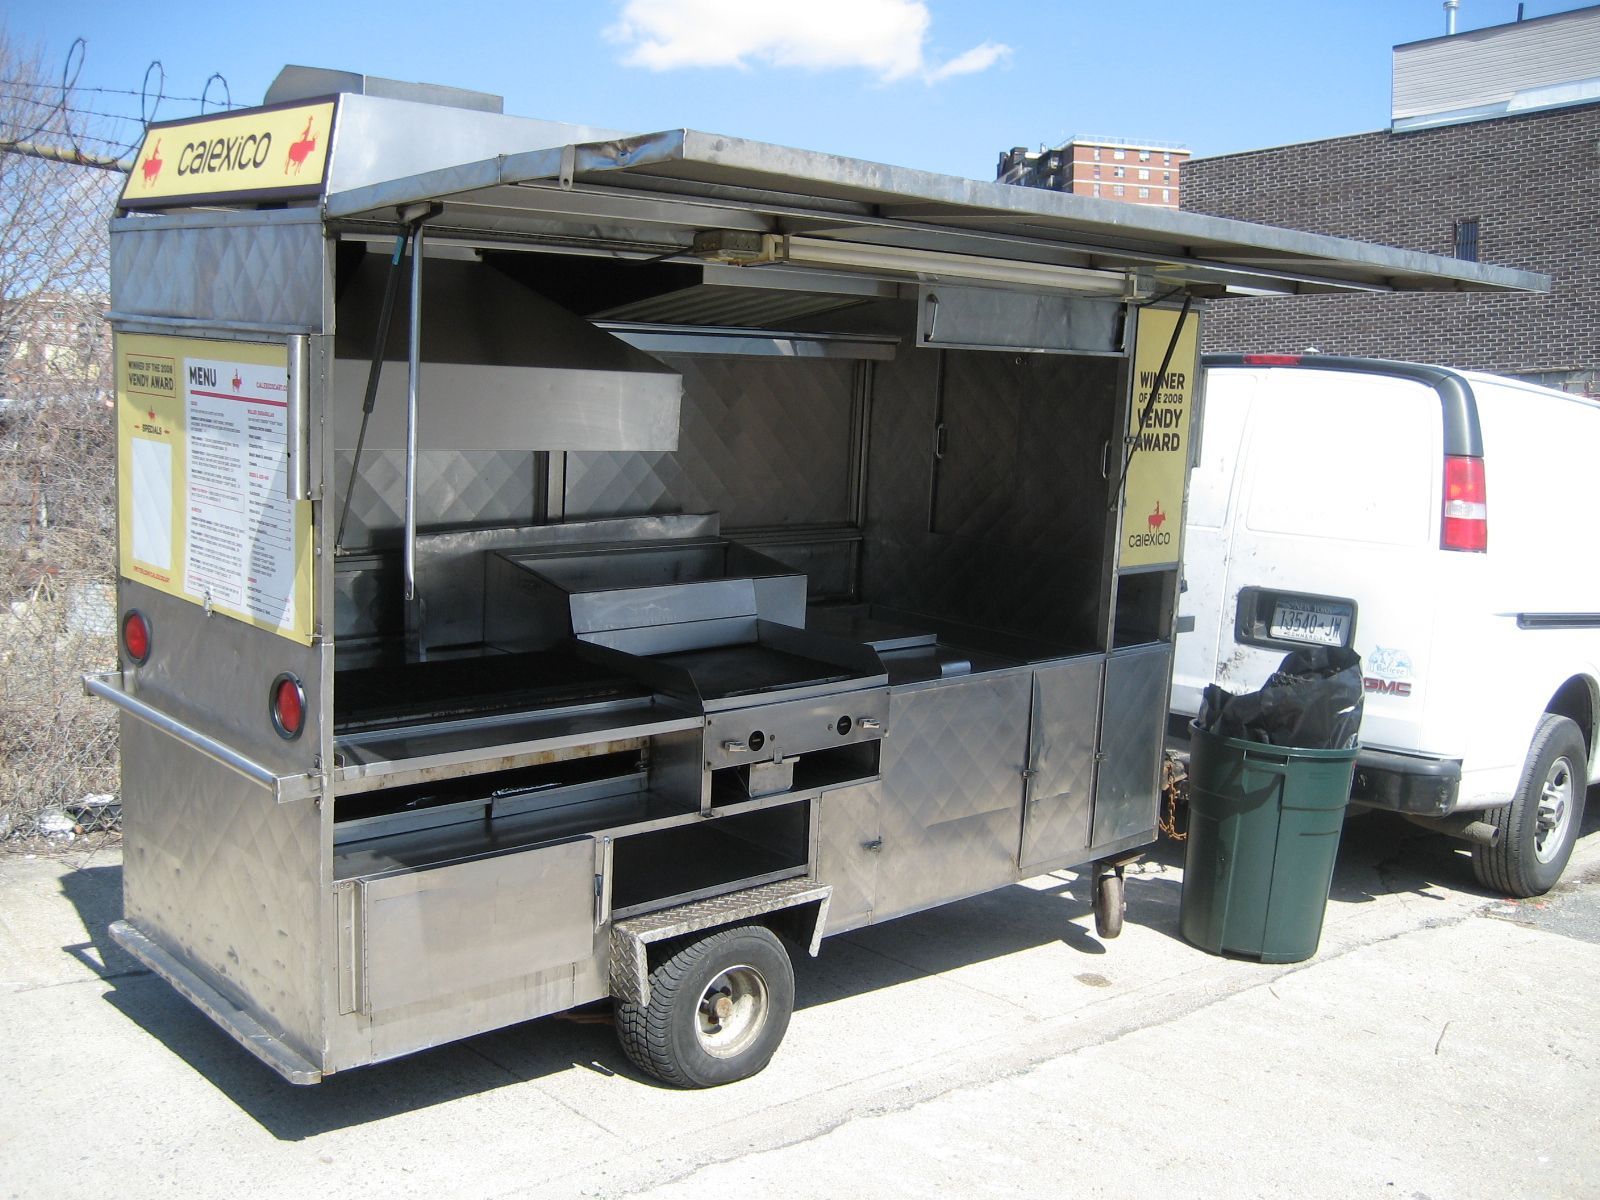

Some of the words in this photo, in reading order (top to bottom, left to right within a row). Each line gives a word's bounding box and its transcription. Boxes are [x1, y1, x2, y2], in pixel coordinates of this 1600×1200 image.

[178, 132, 272, 177] calexico
[128, 361, 144, 370] WINNER
[145, 363, 151, 371] OF
[151, 363, 160, 372] THE
[161, 364, 173, 374] 2008
[189, 366, 217, 387] MENU
[128, 373, 150, 388] VENDY
[151, 376, 174, 391] AWARD
[1138, 392, 1148, 403] OF
[1163, 393, 1183, 404] 2008
[1137, 408, 1183, 428] VENDY
[142, 424, 162, 435] SPECIALS
[1133, 433, 1180, 451] AWARD
[1128, 531, 1171, 548] calexico
[1363, 677, 1412, 696] GMC
